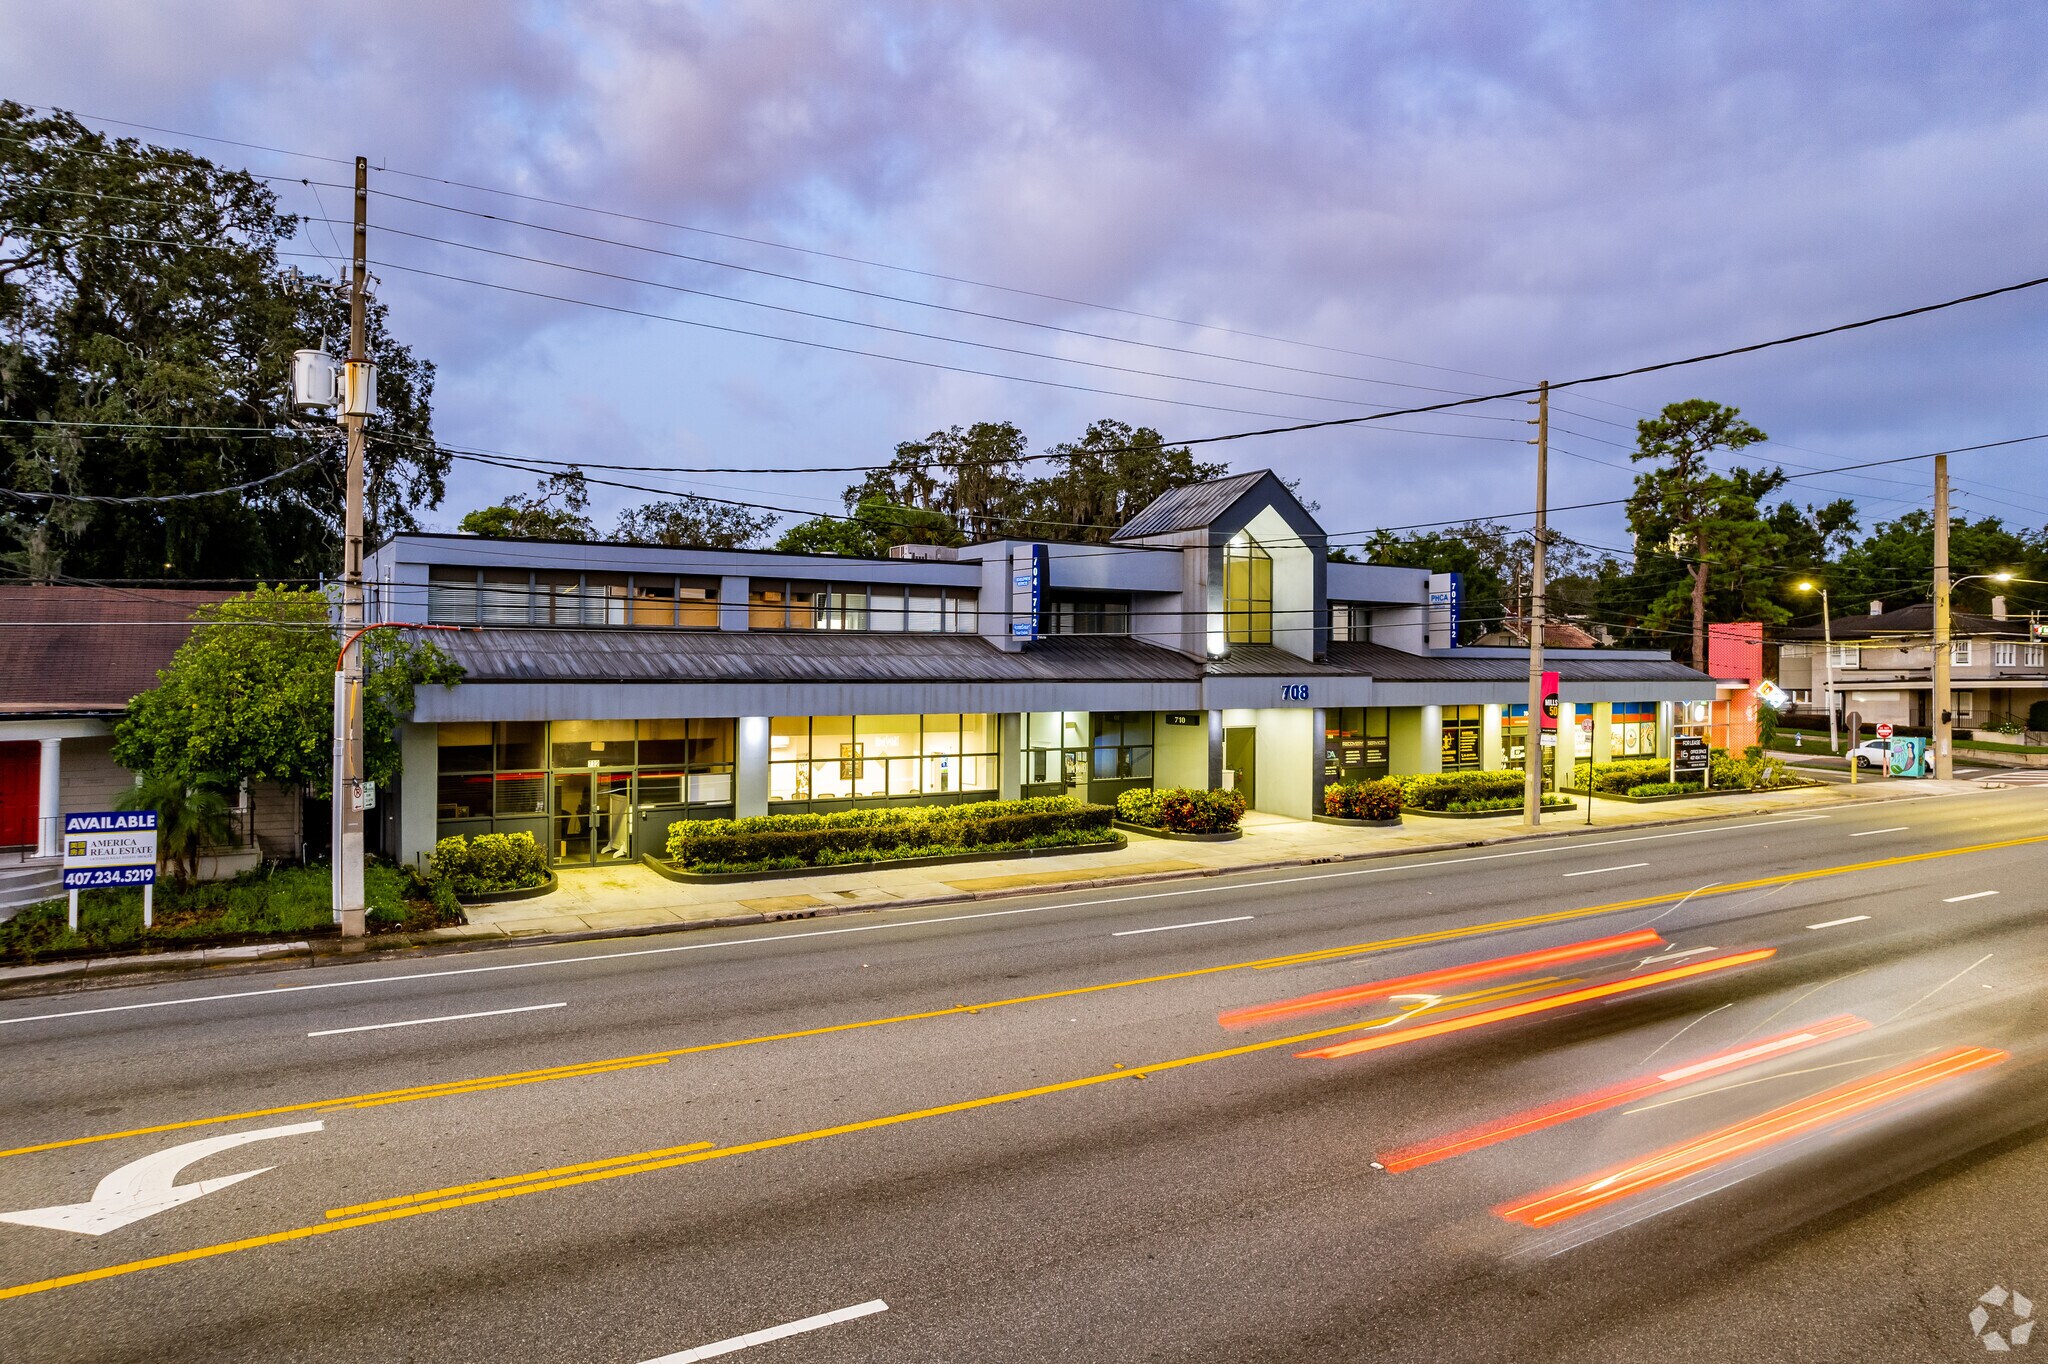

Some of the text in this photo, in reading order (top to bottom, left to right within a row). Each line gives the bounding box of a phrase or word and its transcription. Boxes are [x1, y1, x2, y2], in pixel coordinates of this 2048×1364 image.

[1281, 684, 1309, 701] 708
[1549, 706, 1558, 716] 50
[1174, 716, 1186, 724] 710
[67, 815, 156, 831] AVAILABLE
[91, 839, 137, 848] AMERICA
[90, 848, 117, 856] REAL
[119, 846, 153, 855] ESTATE
[65, 868, 154, 886] 407.234.5219
